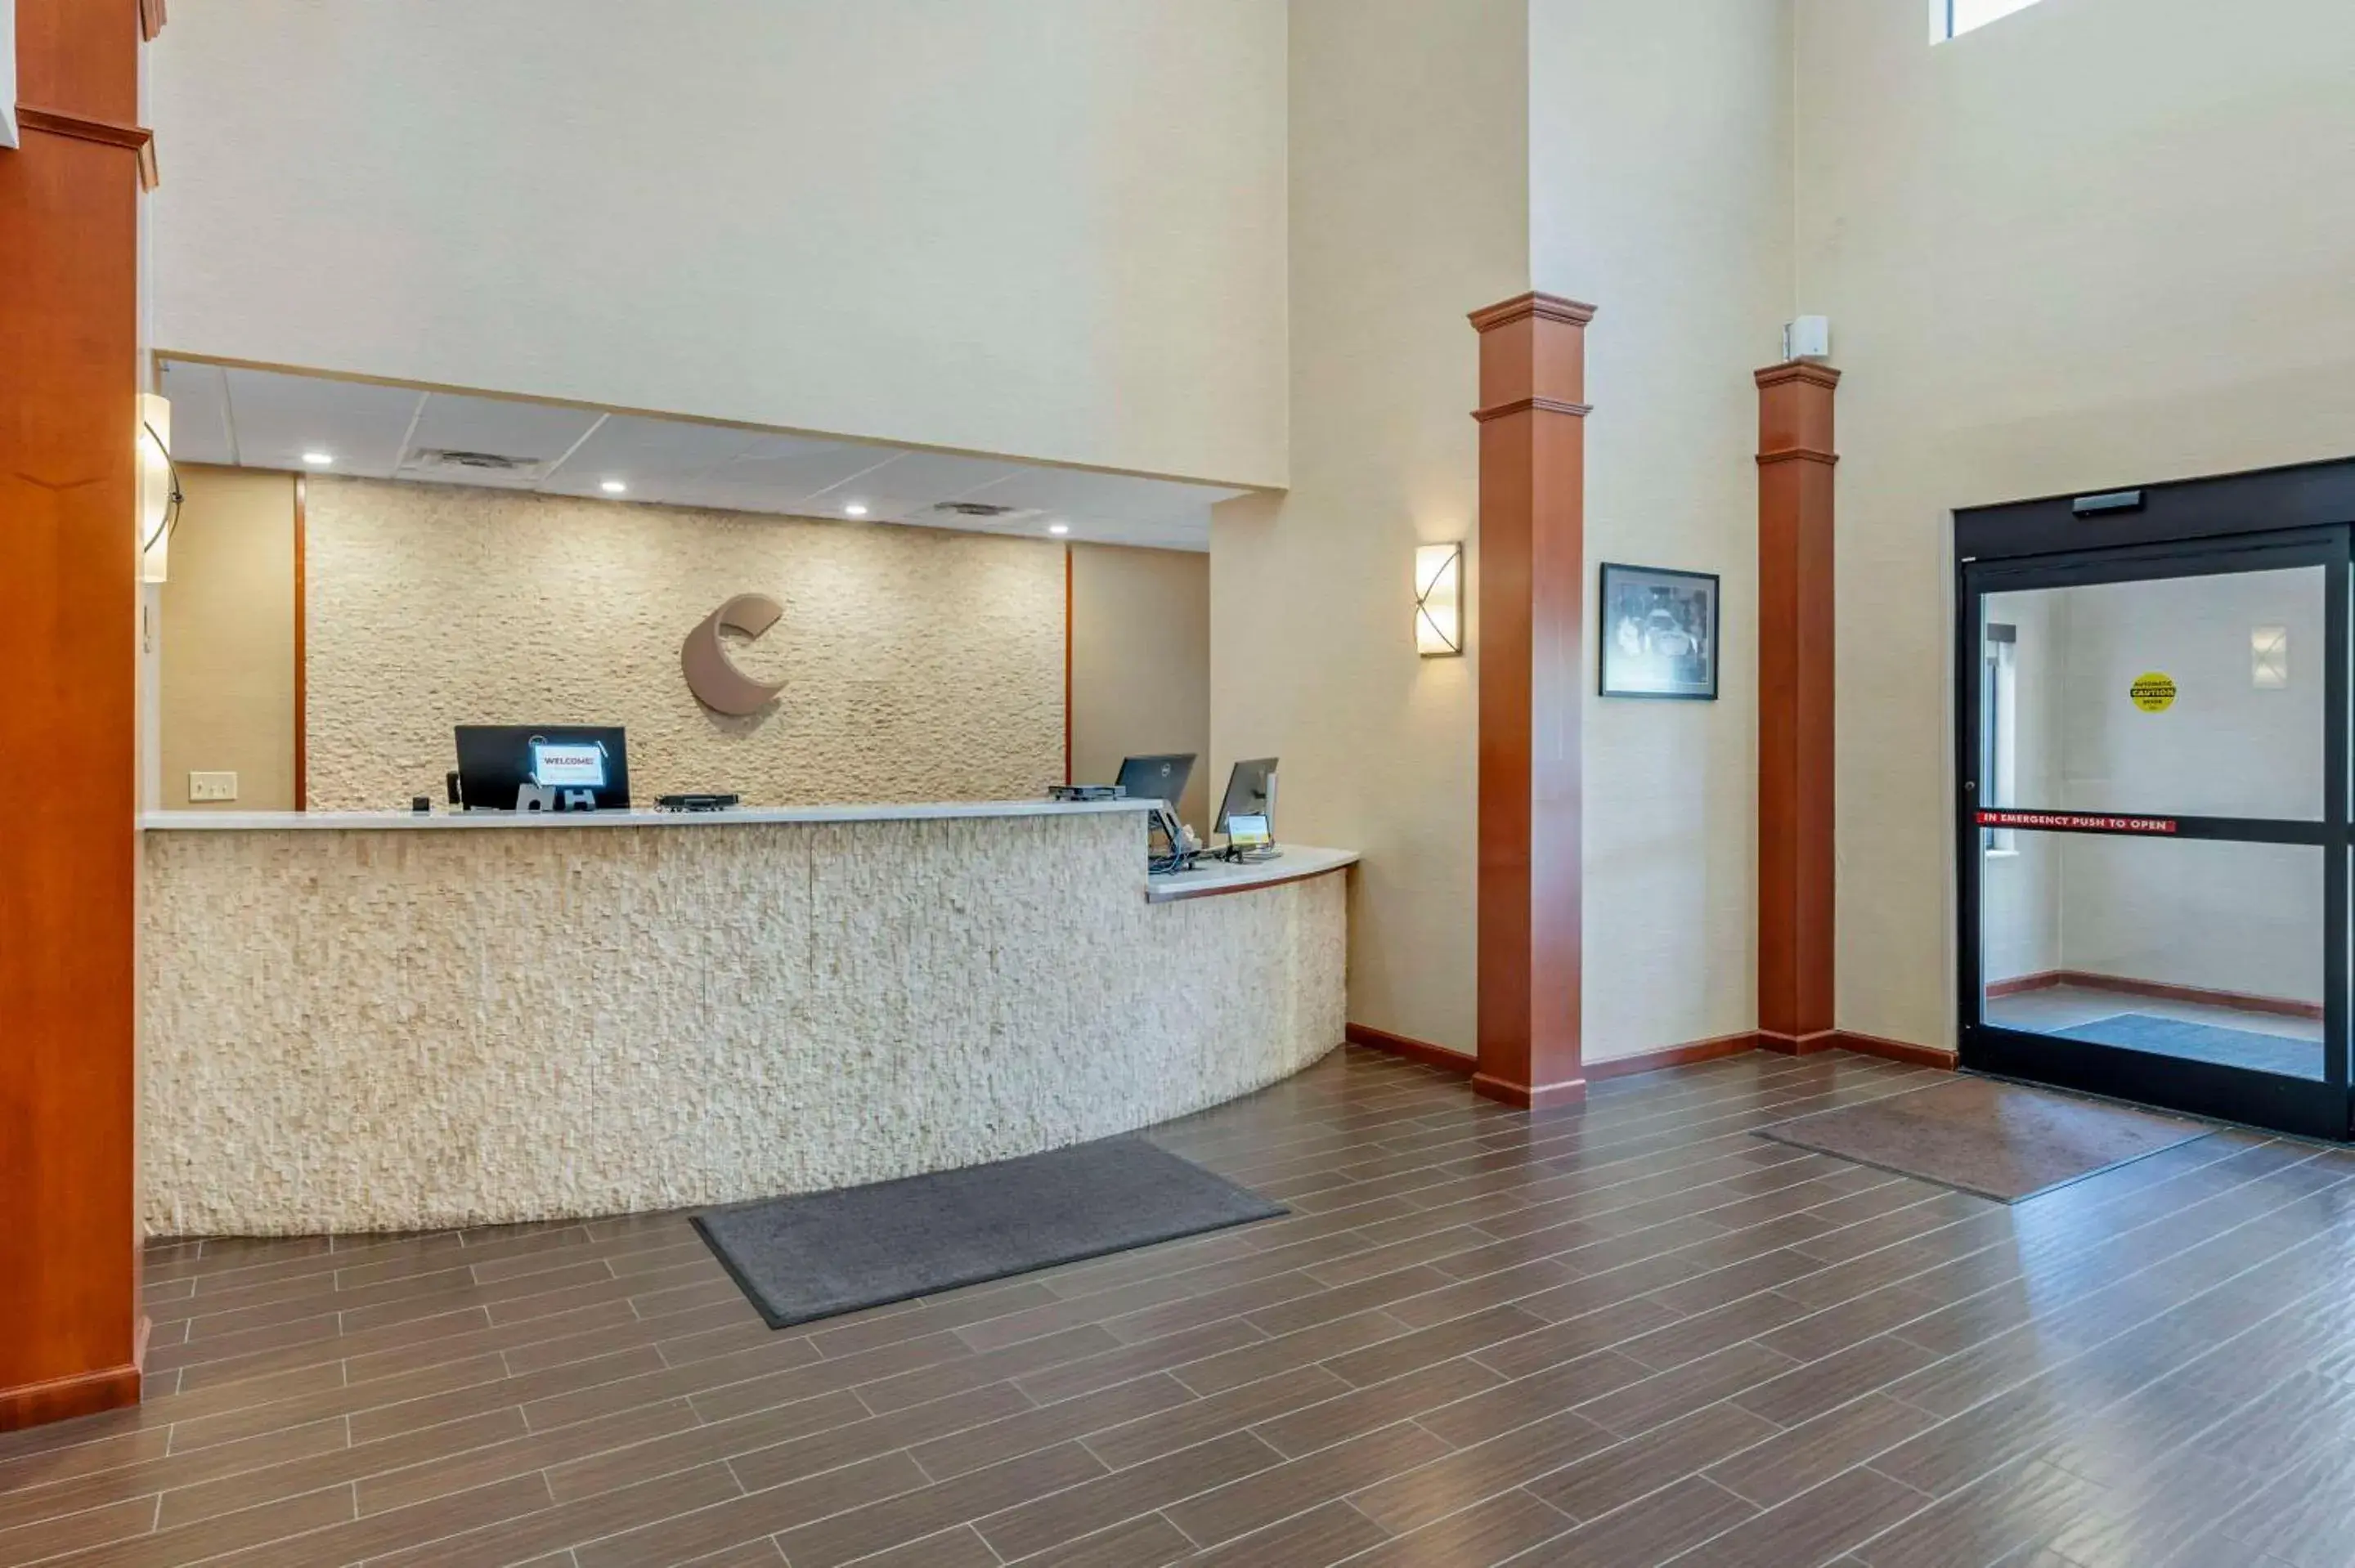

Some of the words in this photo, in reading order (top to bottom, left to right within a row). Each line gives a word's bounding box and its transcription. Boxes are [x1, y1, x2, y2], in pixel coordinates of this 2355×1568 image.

[1984, 813, 1996, 822] IN
[2001, 814, 2068, 825] EMERGENCY
[2073, 818, 2105, 827] PUSH
[2110, 819, 2125, 827] TO
[2130, 821, 2166, 830] OPEN
